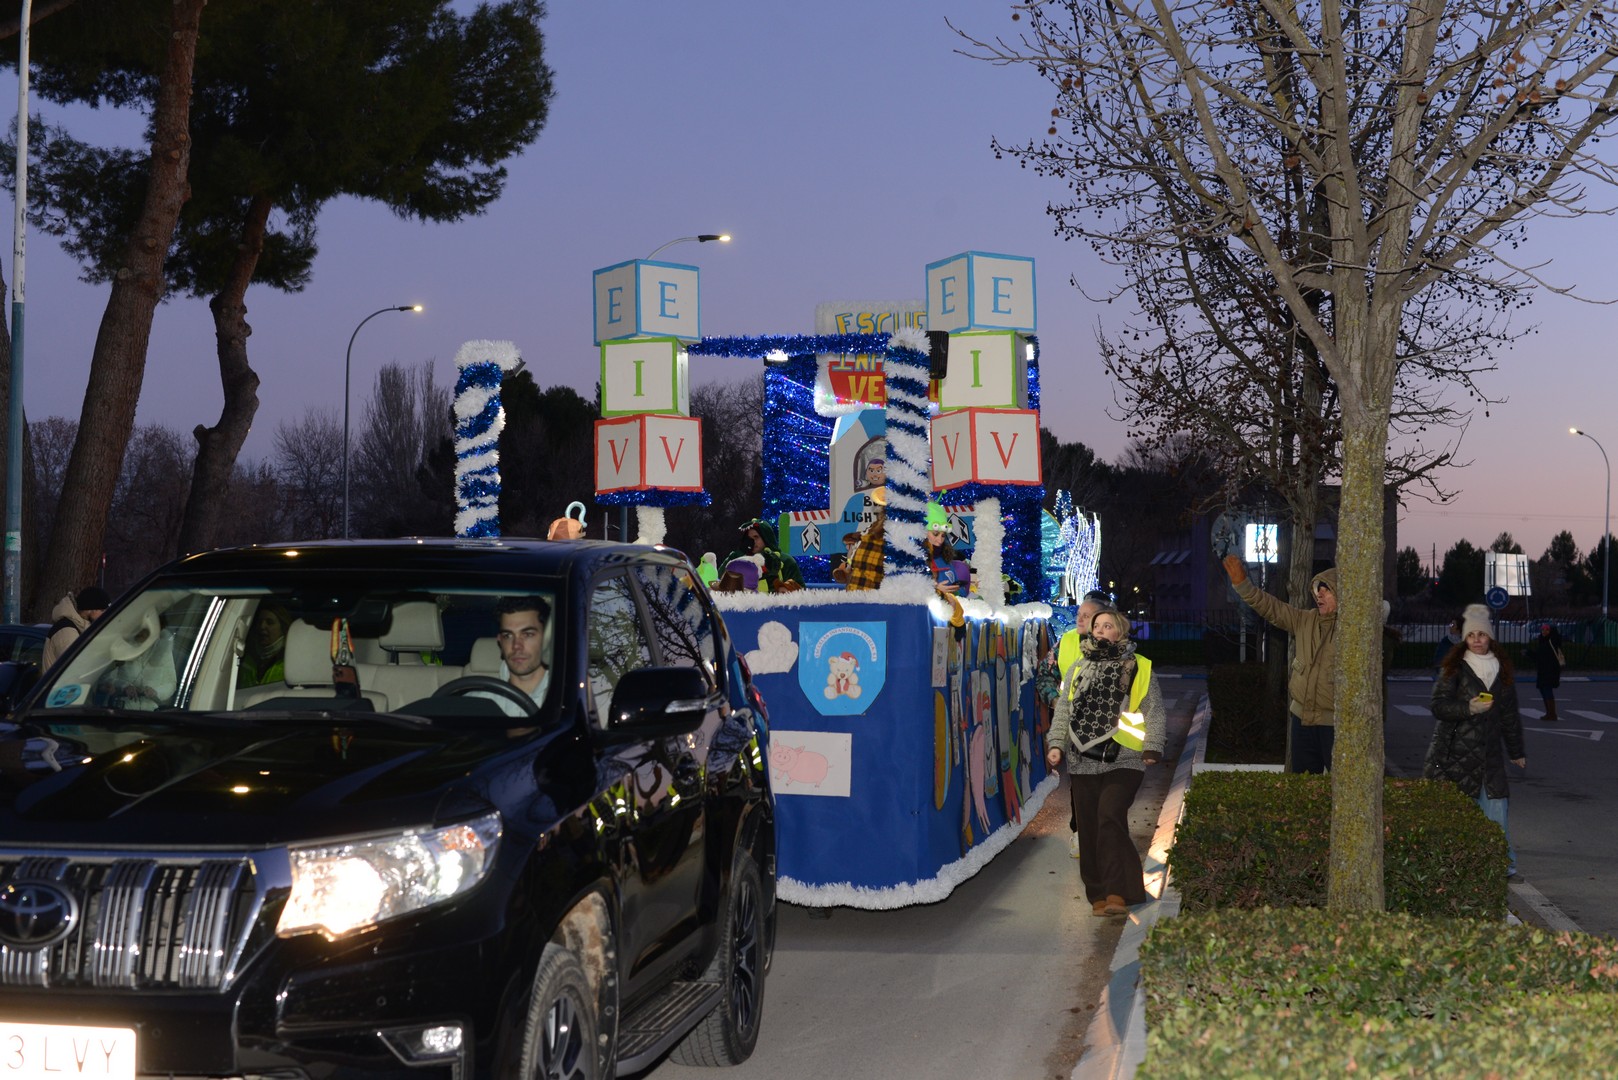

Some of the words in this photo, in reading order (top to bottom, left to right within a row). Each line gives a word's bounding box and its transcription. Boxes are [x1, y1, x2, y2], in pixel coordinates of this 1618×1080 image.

[608, 287, 623, 324] E
[658, 281, 679, 319] E
[940, 276, 956, 315] E
[992, 276, 1013, 314] E
[633, 360, 645, 397] I
[970, 350, 983, 388] I
[608, 438, 629, 475] V
[659, 436, 685, 473] V
[941, 432, 960, 470] V
[990, 431, 1018, 469] V
[44, 1036, 116, 1073] LVY
